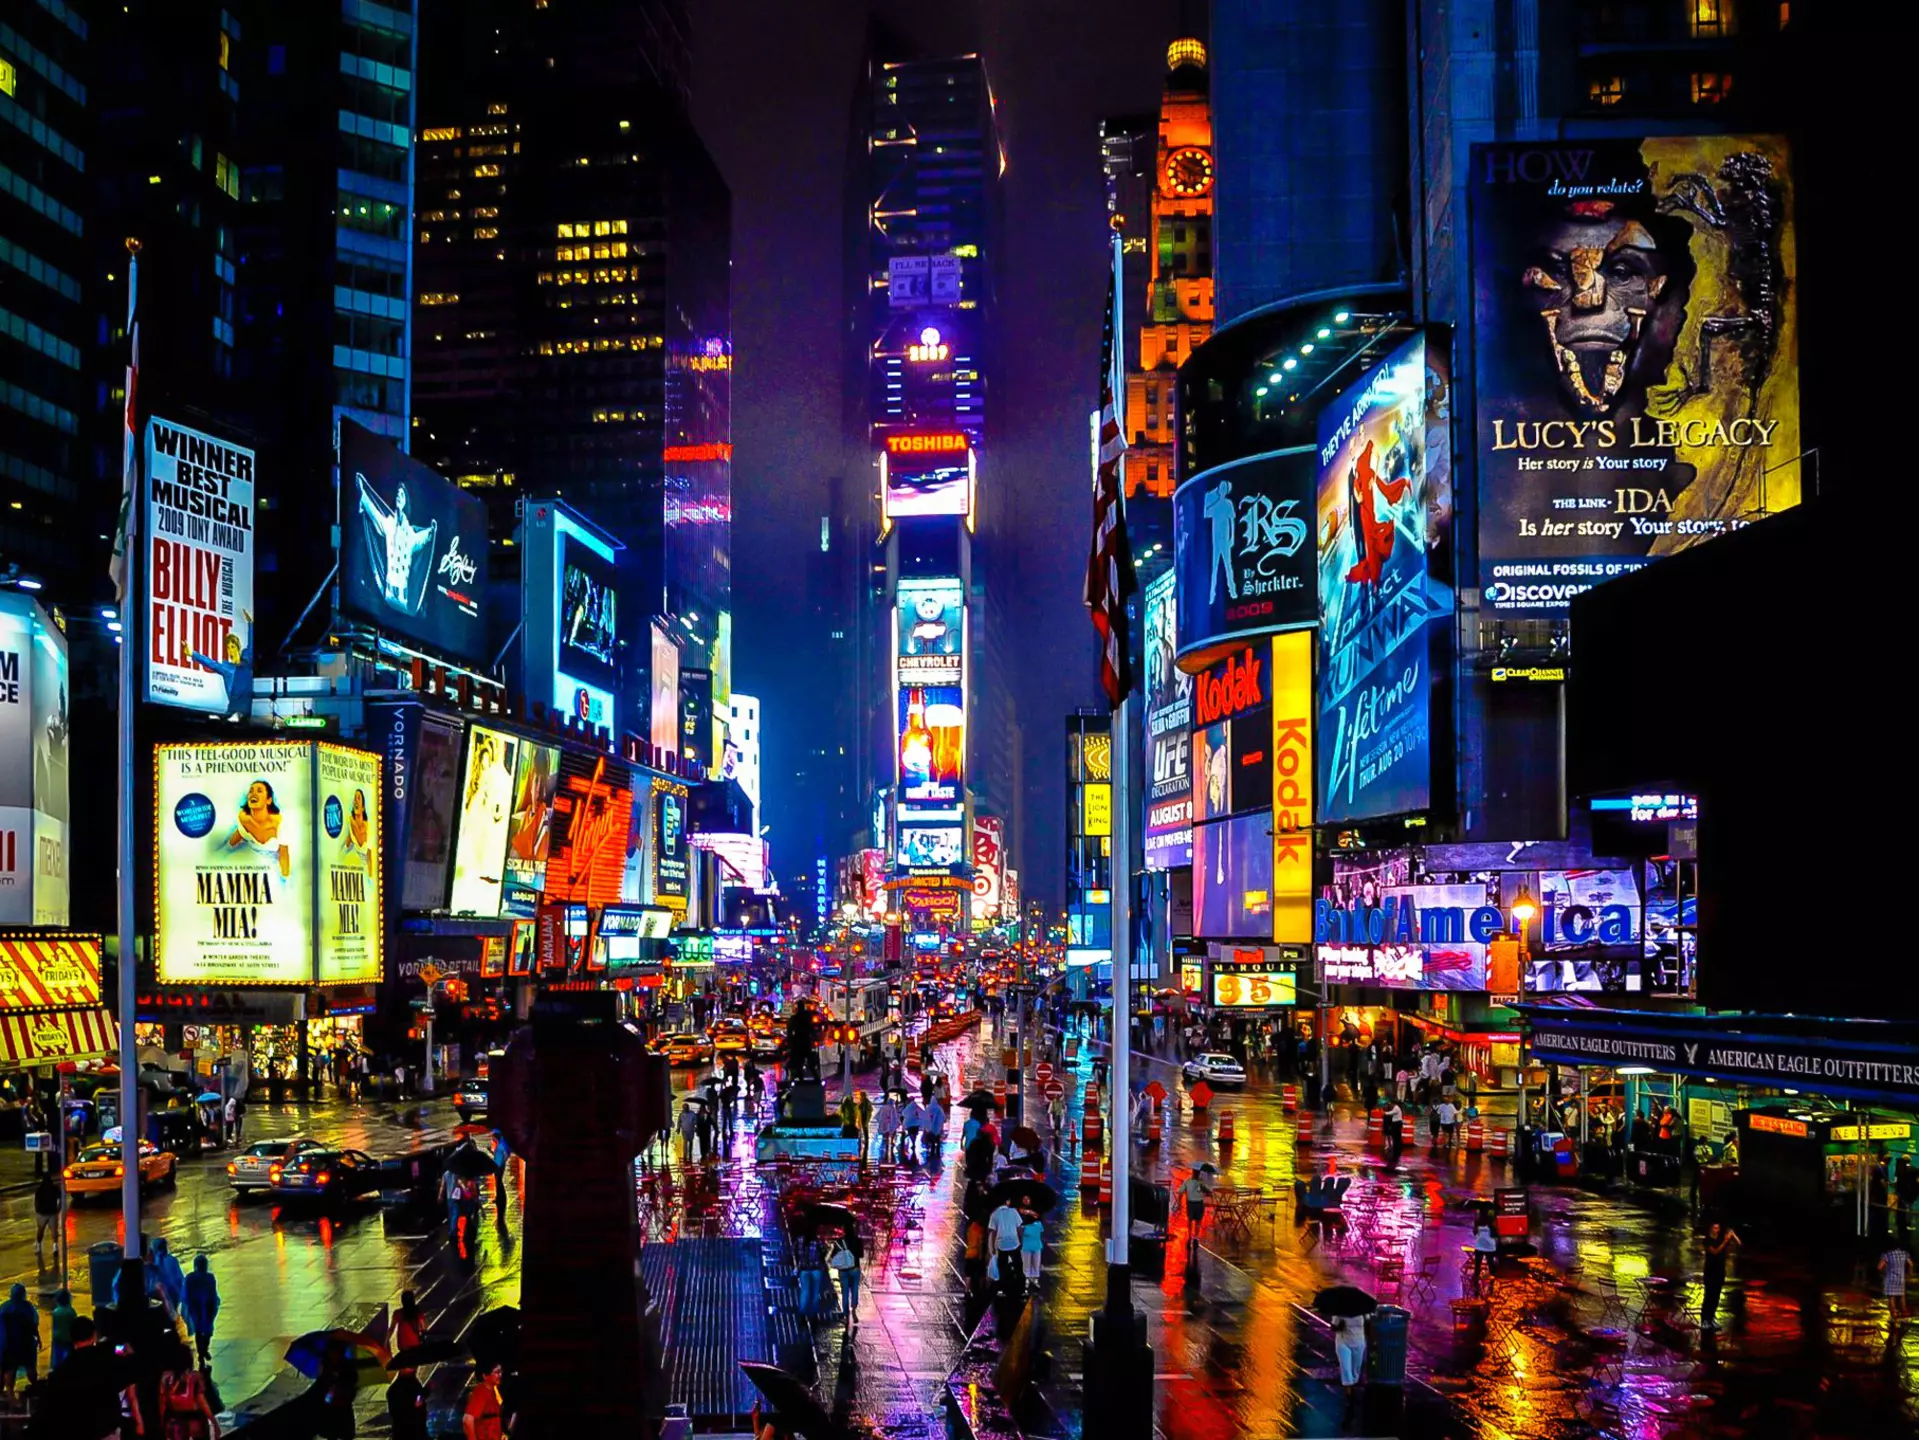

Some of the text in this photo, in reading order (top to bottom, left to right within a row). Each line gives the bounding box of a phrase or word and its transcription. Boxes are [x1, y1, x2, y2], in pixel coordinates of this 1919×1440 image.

[1485, 150, 1594, 183] HOW
[1548, 178, 1644, 198] do you relate?
[888, 435, 967, 452] TOSHIBA
[1322, 415, 1351, 466] THEY'VE
[1491, 417, 1779, 451] LUCY'S LEGACY
[152, 422, 252, 482] WINNER
[1518, 456, 1667, 473] Her story is Your story
[177, 460, 231, 502] BEST
[151, 477, 251, 531] MUSICAL
[1553, 499, 1576, 508] THE
[1613, 488, 1674, 514] IDA
[158, 506, 245, 553] 2009 TONY AWARD
[1519, 519, 1537, 536] Is
[1541, 518, 1574, 537] her
[1577, 519, 1623, 539] story
[1630, 517, 1672, 535] Your
[152, 536, 221, 613] BILLY
[221, 556, 234, 616] THE MUSICAL
[1493, 564, 1551, 577] ORIGINAL
[1553, 564, 1603, 576] FOSSILS
[1606, 564, 1622, 575] OF
[1516, 601, 1544, 609] SQUARE
[152, 602, 233, 674] ELLIOT
[899, 656, 961, 669] CHEVROLET
[1196, 648, 1262, 726] Kodak
[1326, 655, 1420, 814] Lifetime
[181, 762, 192, 774] IS
[195, 762, 203, 774] A
[259, 746, 309, 761] MUSICAL
[393, 707, 405, 800] VORNADO
[1153, 731, 1188, 782] UFC
[1378, 749, 1393, 776] AUG
[1151, 777, 1190, 799] DECLARATION
[1276, 717, 1308, 865] Kodak
[1150, 804, 1185, 828] AUGUST
[331, 870, 366, 902] MAMMA
[909, 867, 950, 876] Panasonic
[196, 872, 273, 905] MAMMA
[907, 895, 956, 908] YAHOO!
[213, 906, 257, 939] MIA!
[338, 902, 359, 934] MIA!
[602, 914, 641, 932] VORNADO
[1214, 963, 1297, 972] MARQUIS
[1534, 1034, 1579, 1051] AMERICAN
[1580, 1038, 1611, 1054] EAGLE
[1612, 1041, 1676, 1062] OUTFITTERS
[1708, 1050, 1919, 1086] AMERICAN EAGLE OUTFITTERS
